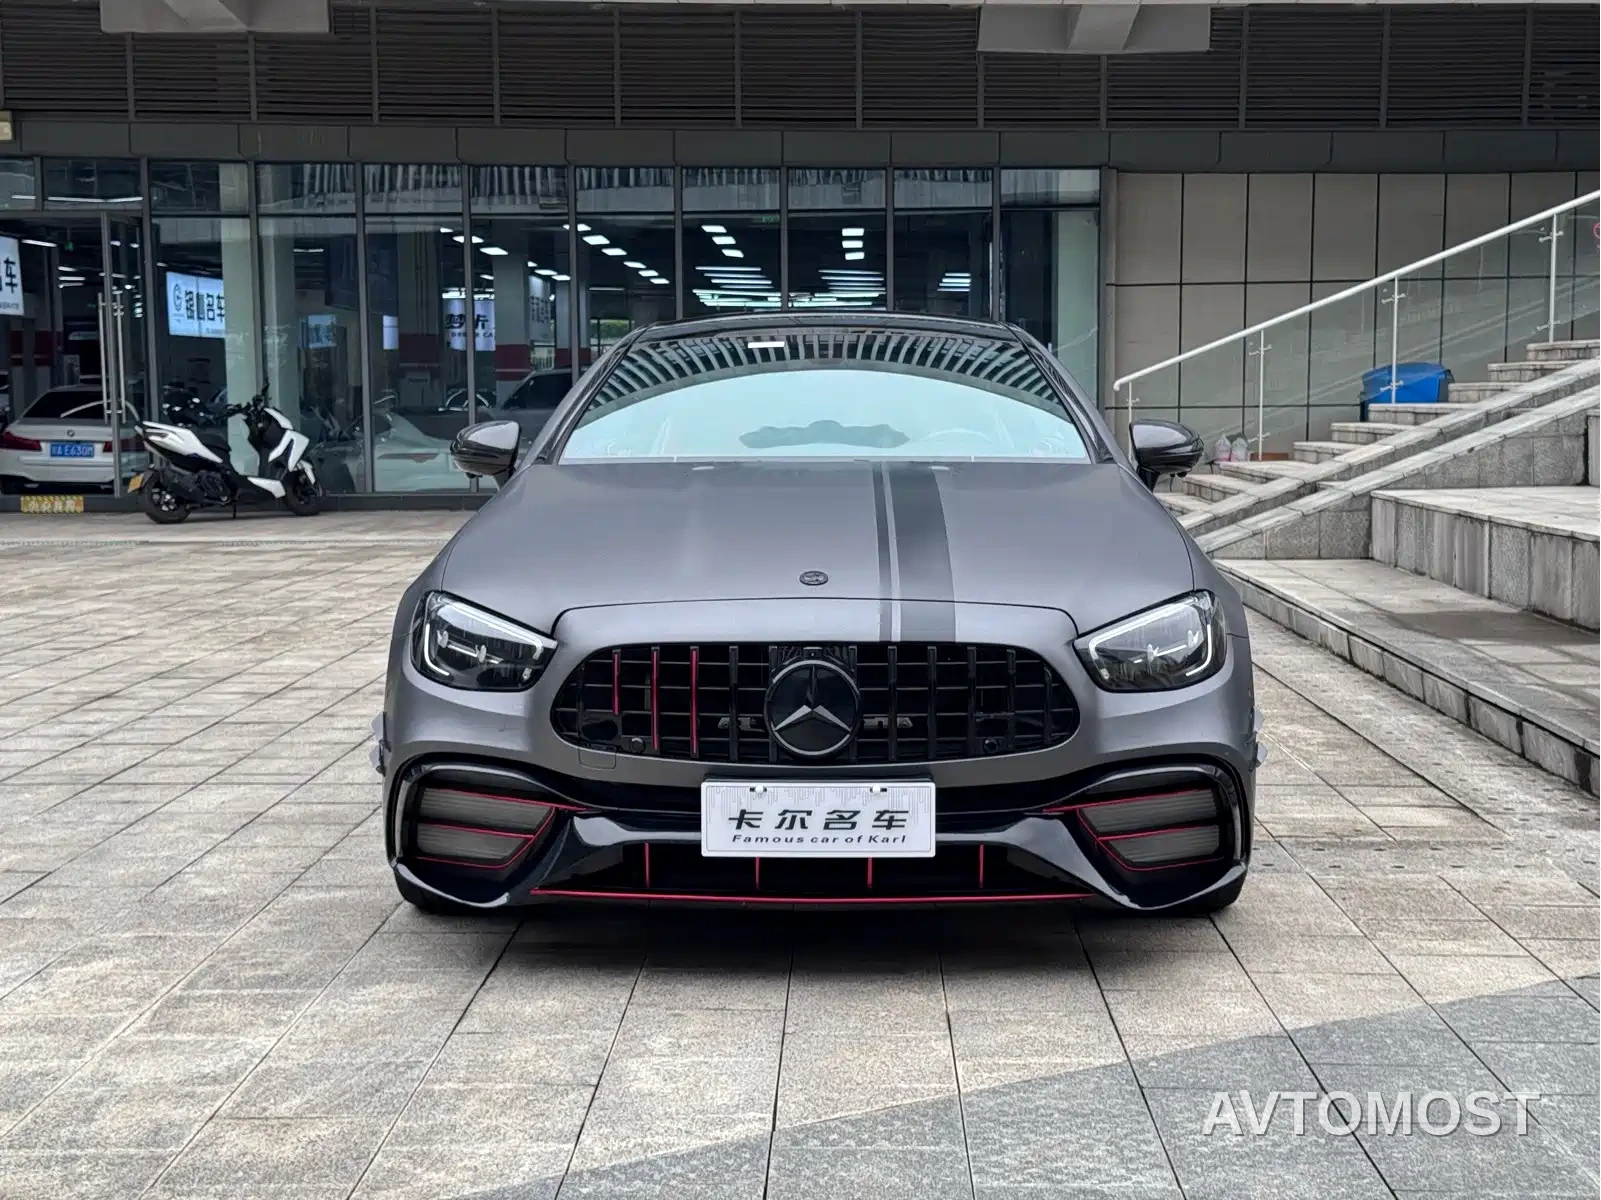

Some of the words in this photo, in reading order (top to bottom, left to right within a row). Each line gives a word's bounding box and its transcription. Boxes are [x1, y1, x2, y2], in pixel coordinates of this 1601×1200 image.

[728, 809, 909, 830] 卡尔名车
[732, 834, 804, 843] Famous
[810, 835, 839, 843] car
[844, 834, 862, 843] of
[868, 834, 906, 843] Karl
